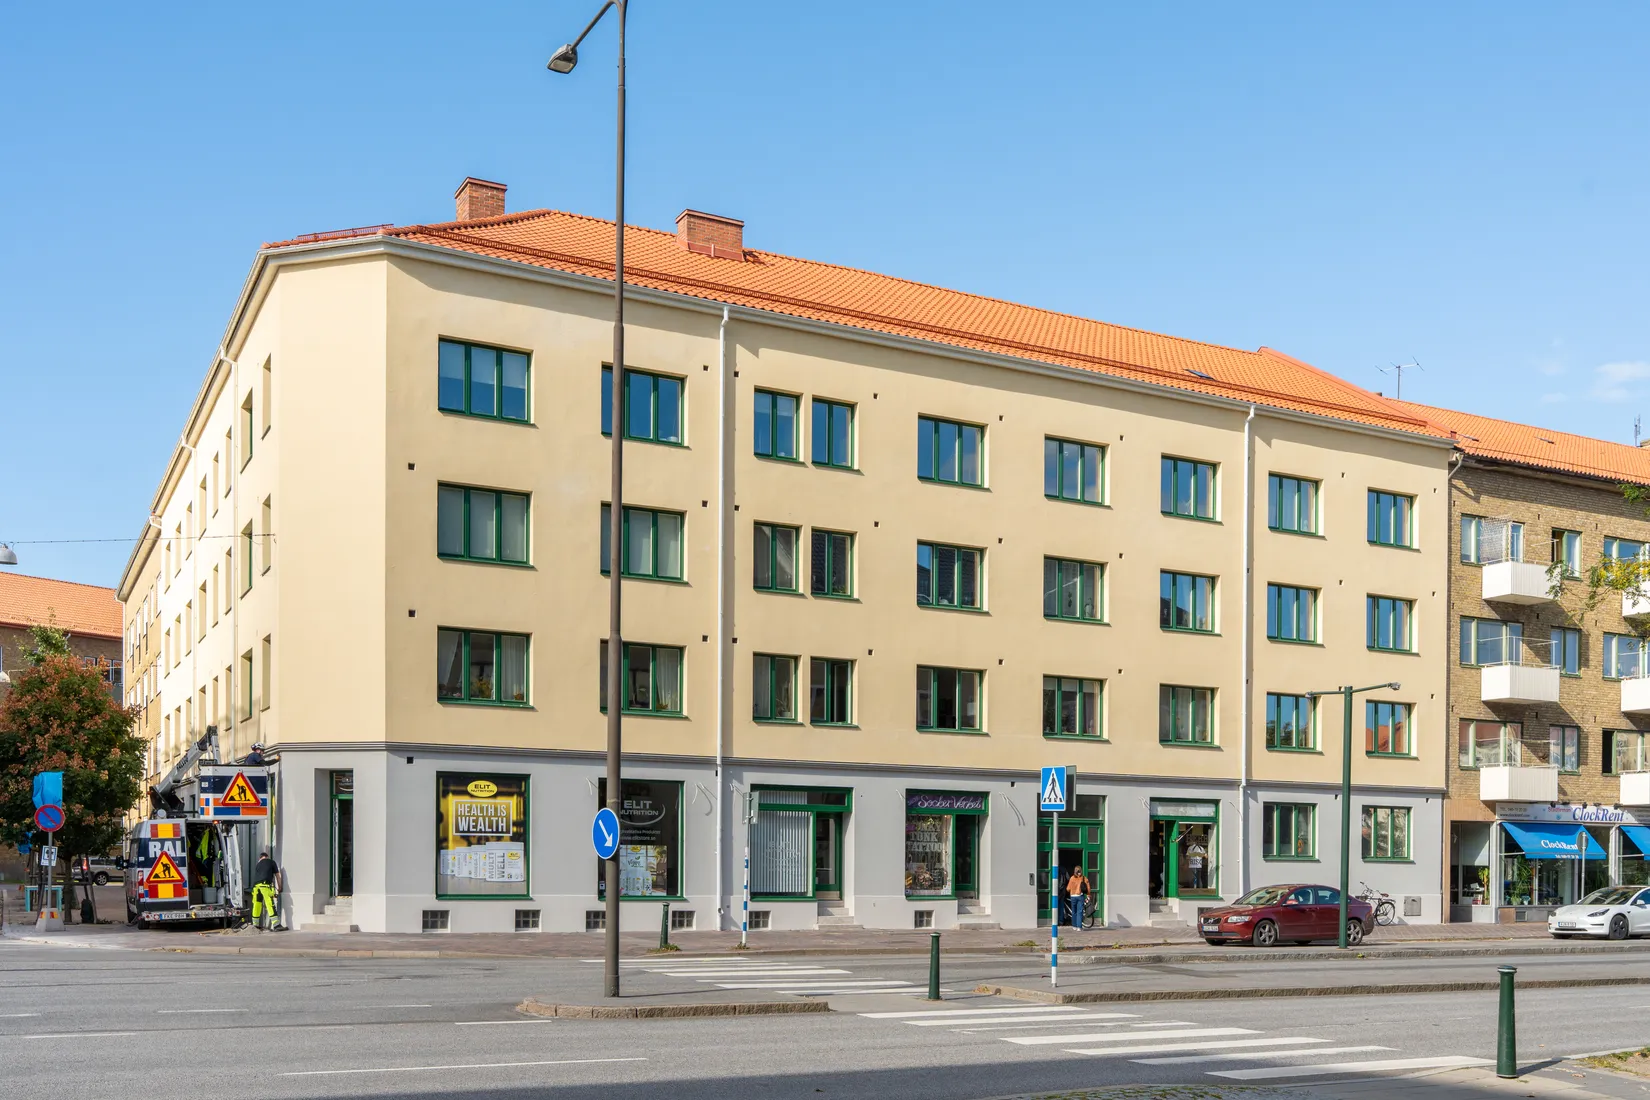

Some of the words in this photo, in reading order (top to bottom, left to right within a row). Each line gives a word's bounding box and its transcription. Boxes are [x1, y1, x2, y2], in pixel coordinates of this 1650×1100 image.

[457, 803, 495, 816] HEALTH
[498, 804, 507, 817] IS
[623, 800, 652, 809] ELIT
[1572, 806, 1624, 822] ClockRent
[458, 817, 507, 832] WEALTH
[149, 840, 187, 858] RAL
[905, 842, 943, 852] TATTOO
[497, 852, 505, 879] WELL
